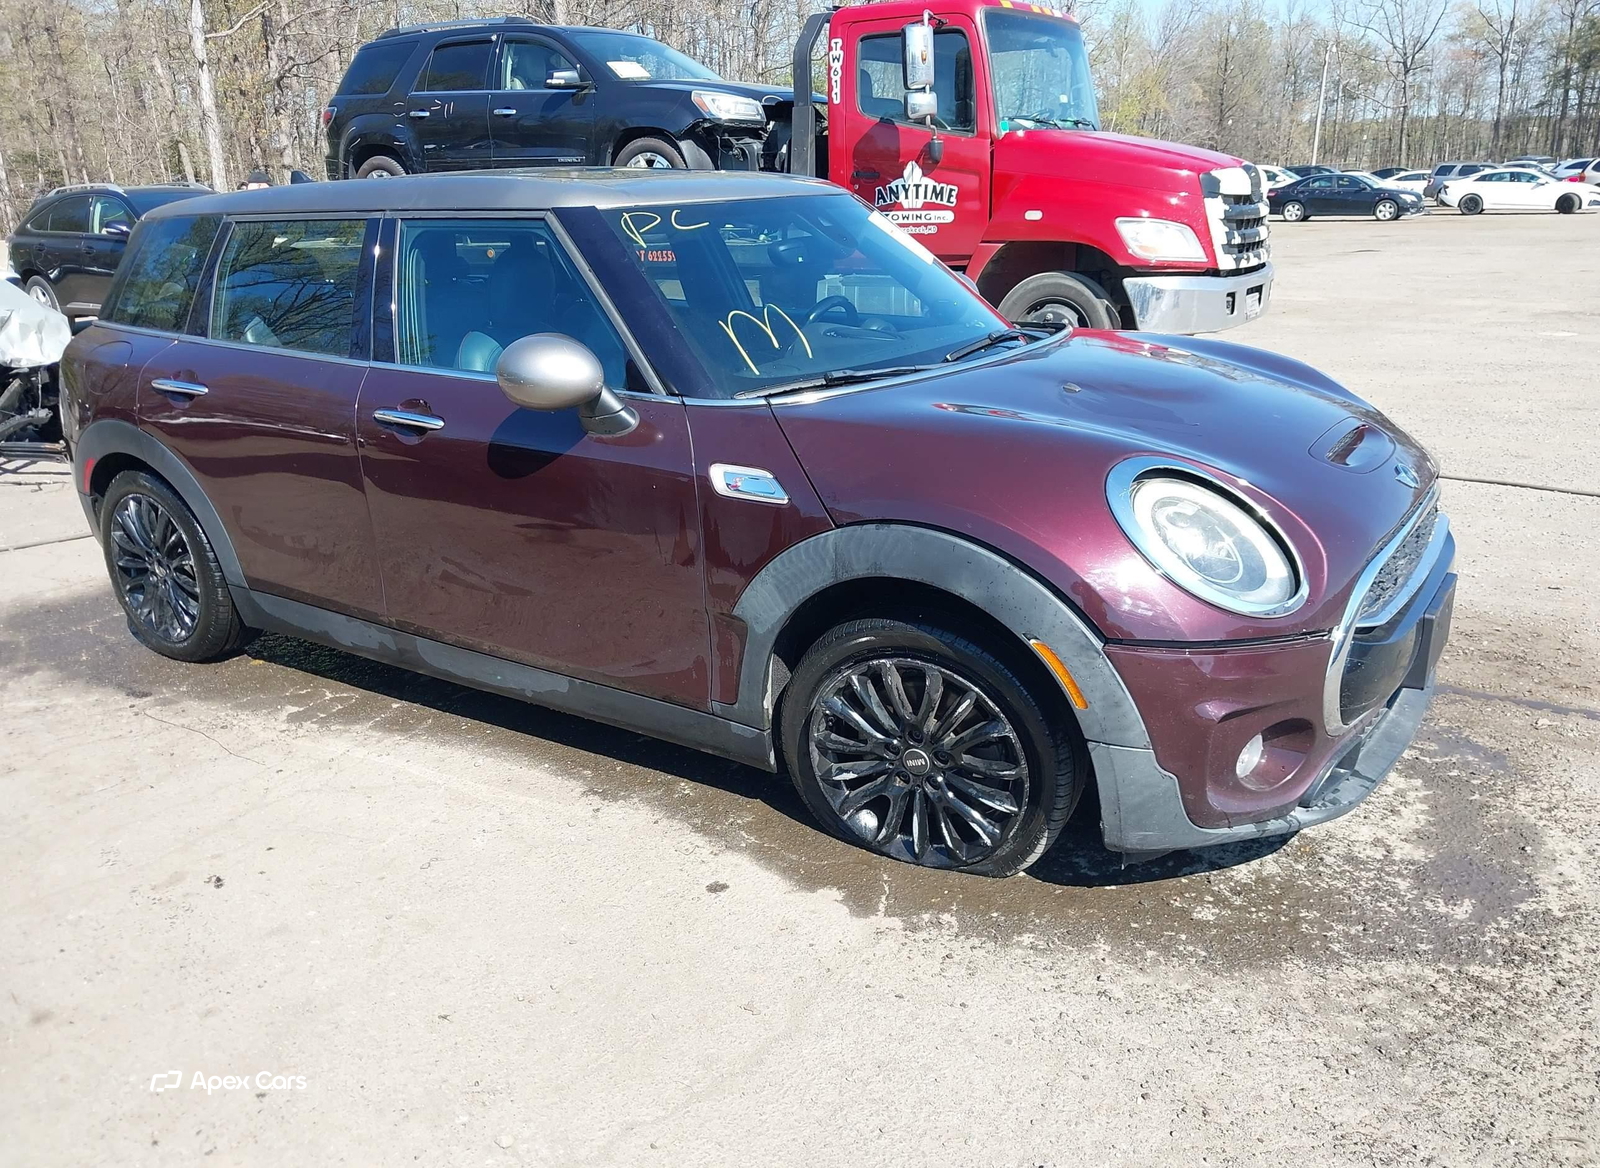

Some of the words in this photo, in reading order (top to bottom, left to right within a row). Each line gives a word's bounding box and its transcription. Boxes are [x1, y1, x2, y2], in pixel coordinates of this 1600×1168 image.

[832, 41, 841, 101] TW611
[876, 184, 956, 206] ANYTIME
[906, 758, 925, 767] MINI
